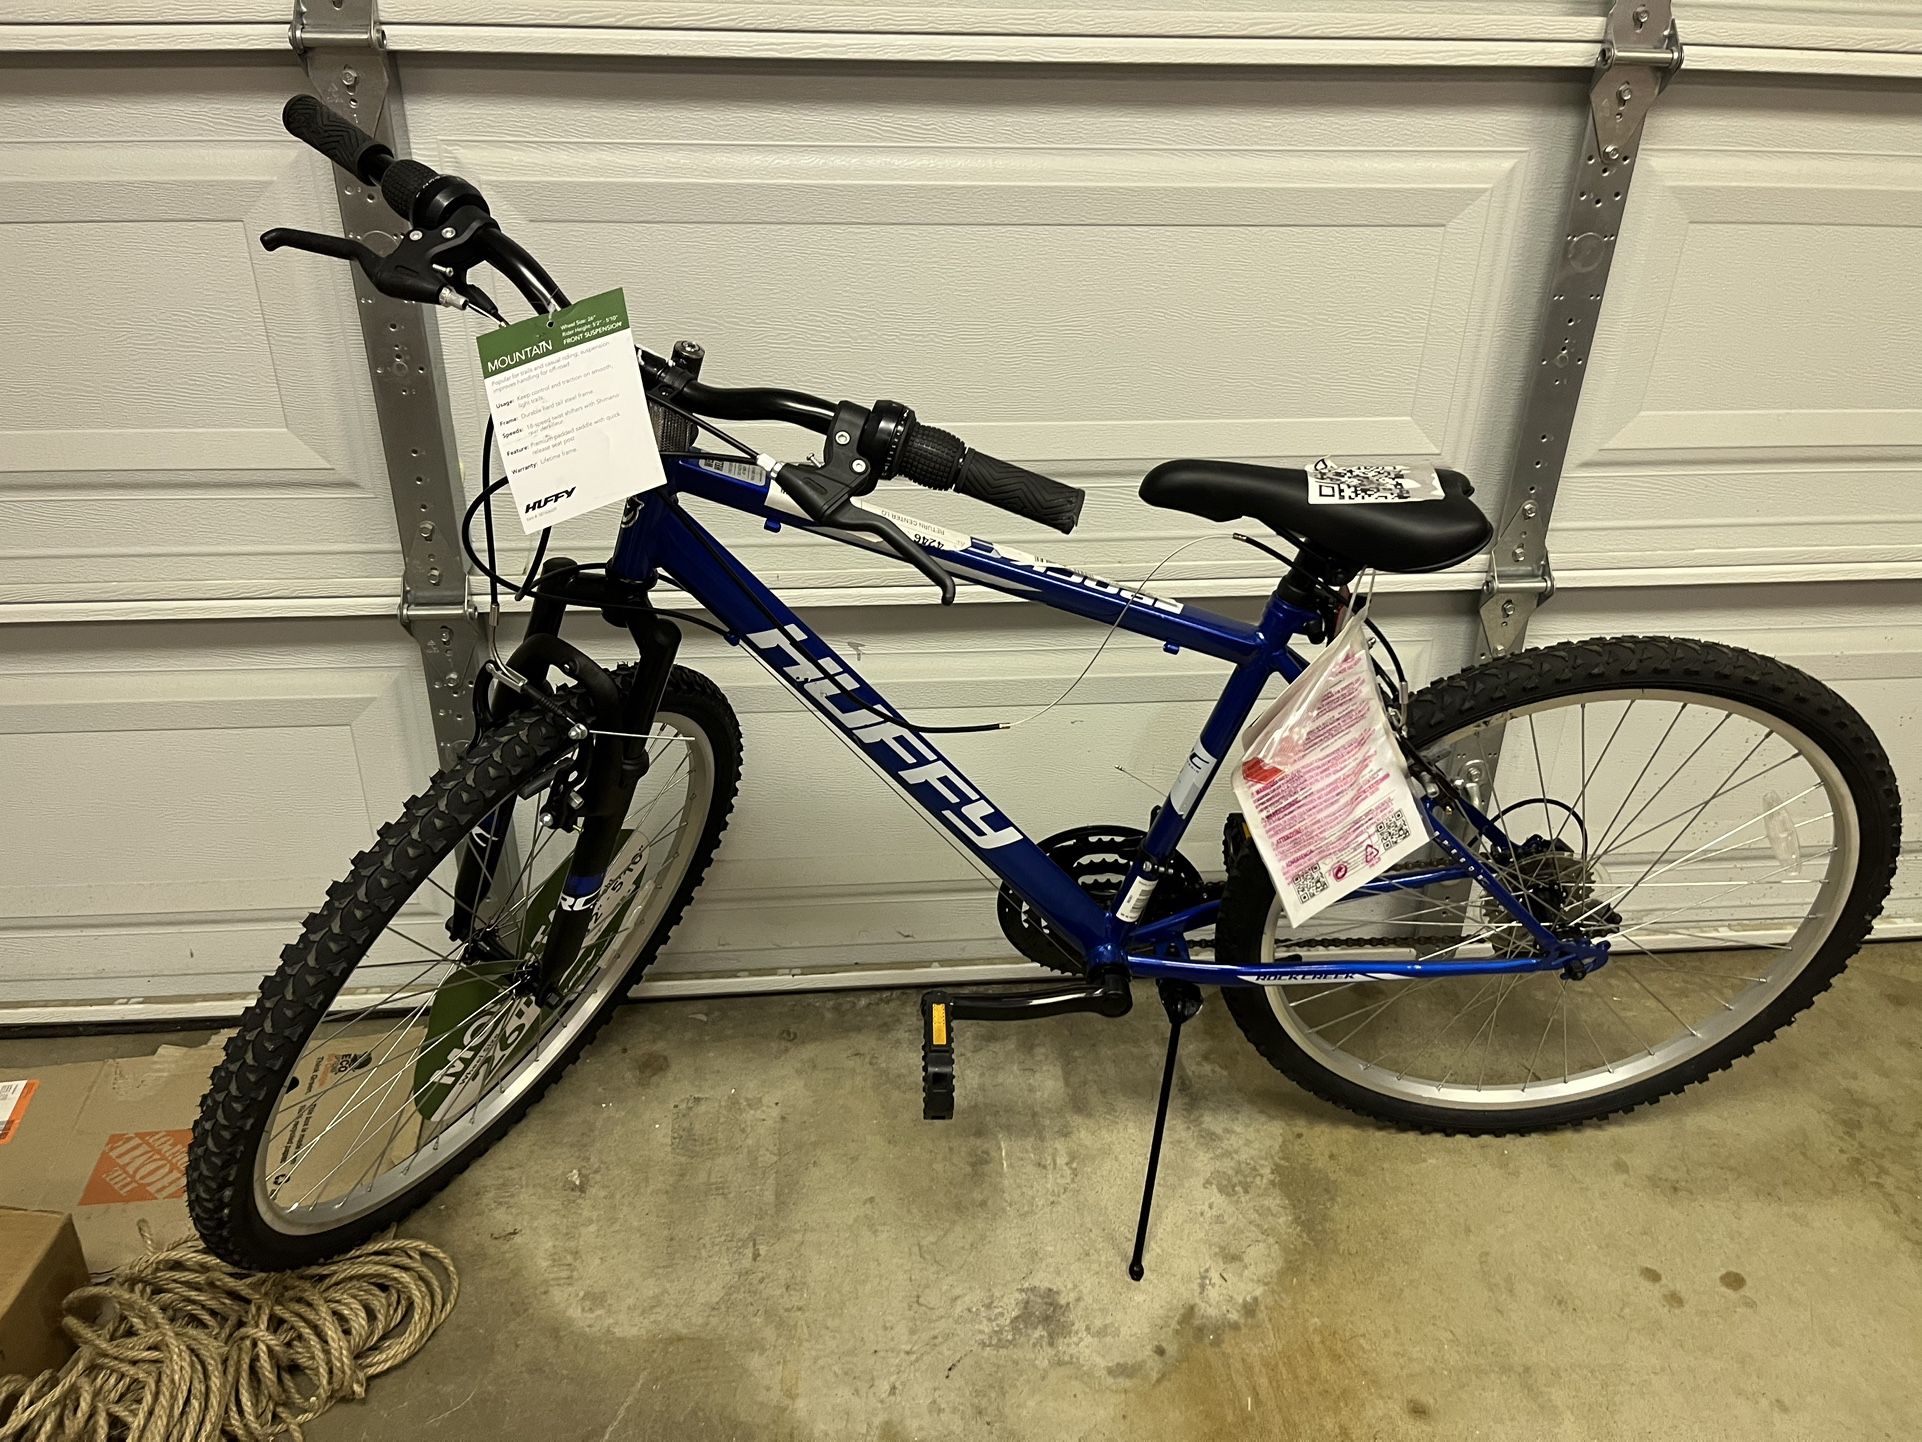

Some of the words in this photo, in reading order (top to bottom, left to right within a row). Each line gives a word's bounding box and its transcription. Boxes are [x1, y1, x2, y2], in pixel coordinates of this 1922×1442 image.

[560, 321, 575, 329] Wheel
[563, 334, 583, 344] FRONT
[584, 320, 622, 337] SUSPENSION
[487, 340, 552, 371] MOUNTAIN
[496, 399, 514, 408] Usage:
[499, 416, 517, 425] Frame:
[506, 445, 528, 455] Feature:
[511, 462, 537, 475] Warranty:
[523, 487, 577, 512] HUFFY
[917, 522, 945, 534] RETURN
[746, 623, 1024, 849] HUFFY
[459, 1052, 484, 1086] Wheel
